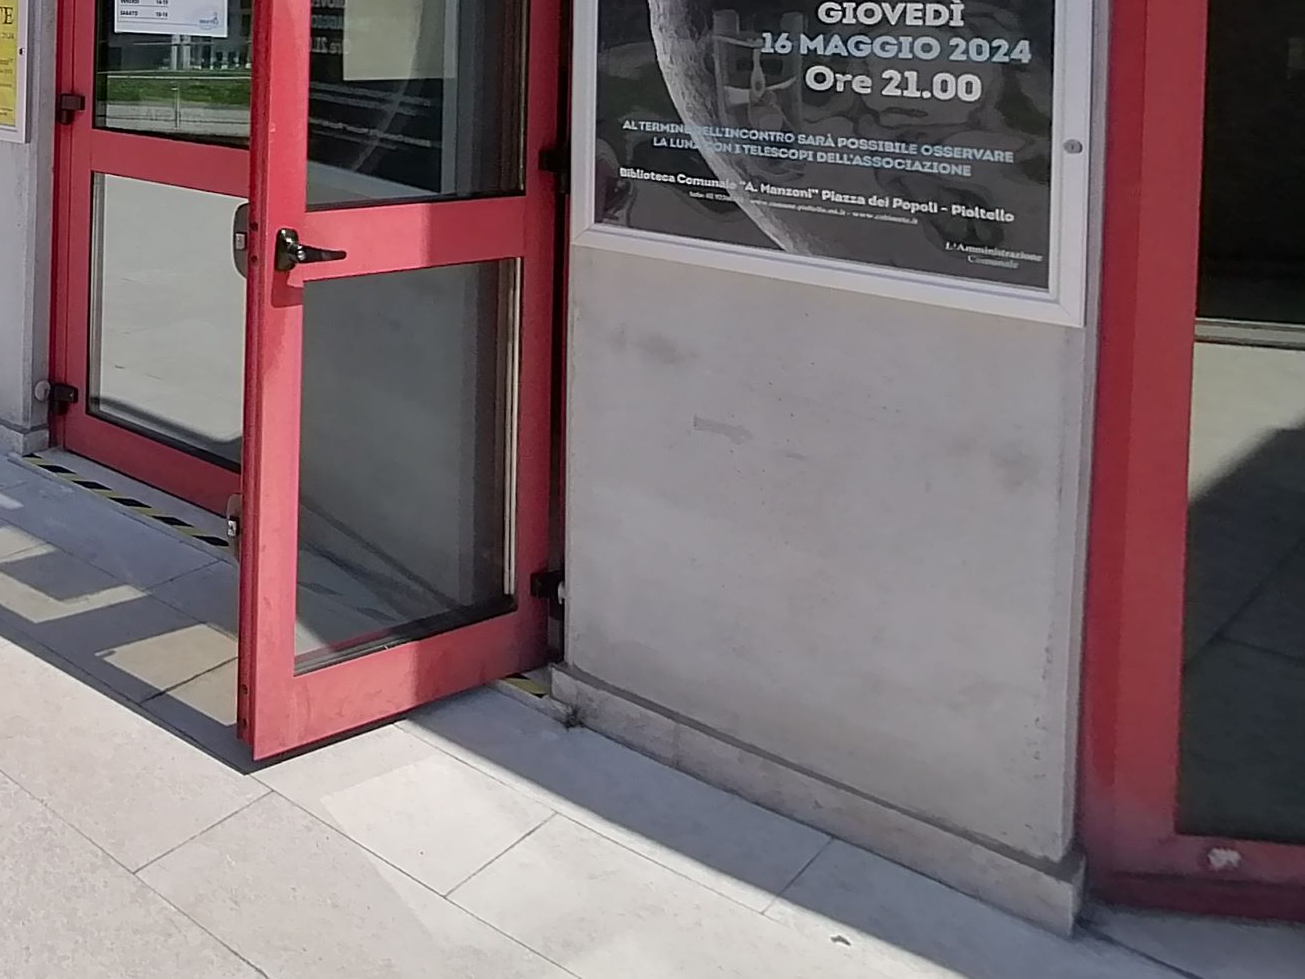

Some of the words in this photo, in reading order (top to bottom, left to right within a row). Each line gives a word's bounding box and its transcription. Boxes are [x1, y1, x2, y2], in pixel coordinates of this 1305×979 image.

[761, 32, 792, 54] 16
[800, 34, 941, 60] MAGGIO
[948, 37, 1032, 64] 2024
[805, 65, 873, 94] Ore
[881, 69, 982, 102] 21.00
[622, 120, 638, 131] AL
[798, 133, 836, 147] SARÀ
[838, 138, 918, 154] POSSIBILE
[920, 145, 1014, 163] OSSERVARE
[653, 136, 667, 147] LA
[743, 144, 814, 163] TELESCOPI
[817, 152, 972, 177] DELL'ASSOCIAZIONE
[619, 167, 676, 183] Biblioteca
[677, 173, 737, 190] Comunale
[822, 190, 866, 205] Piazza
[868, 195, 890, 207] dei
[892, 198, 938, 213] Popoli
[951, 204, 1015, 222] Pioltello
[946, 241, 1043, 262] L'Amministrazione
[968, 254, 1019, 270] Comunale
